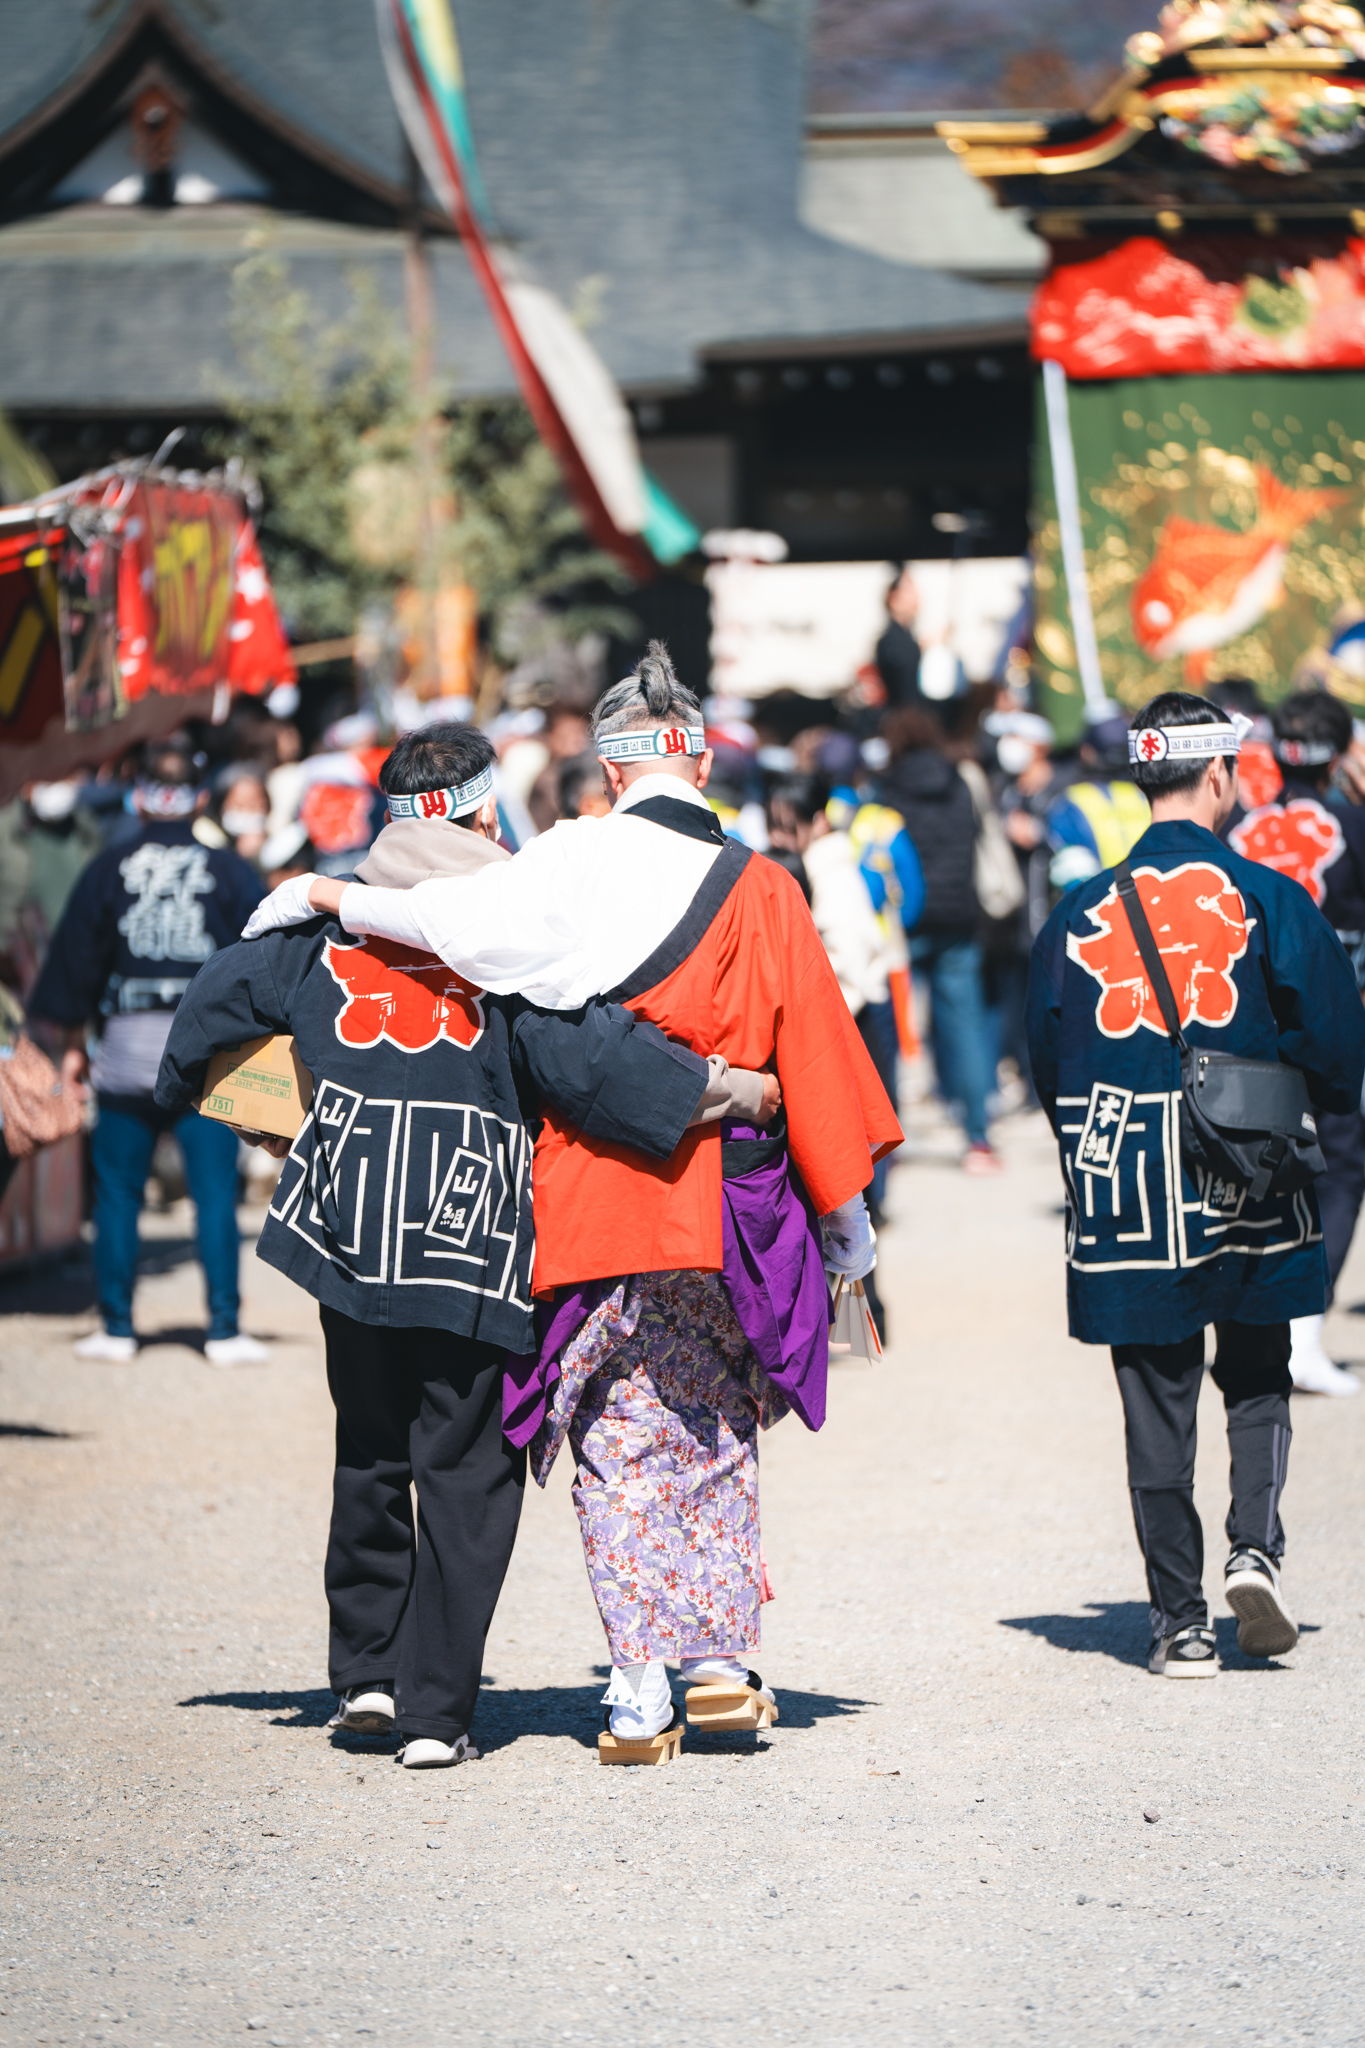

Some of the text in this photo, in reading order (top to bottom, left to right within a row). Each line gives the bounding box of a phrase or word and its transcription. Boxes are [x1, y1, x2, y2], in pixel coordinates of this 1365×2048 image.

[662, 728, 687, 754] 山
[418, 790, 448, 819] 山
[211, 1098, 229, 1112] 751
[440, 1166, 479, 1229] 山組
[1211, 1177, 1238, 1206] 組
